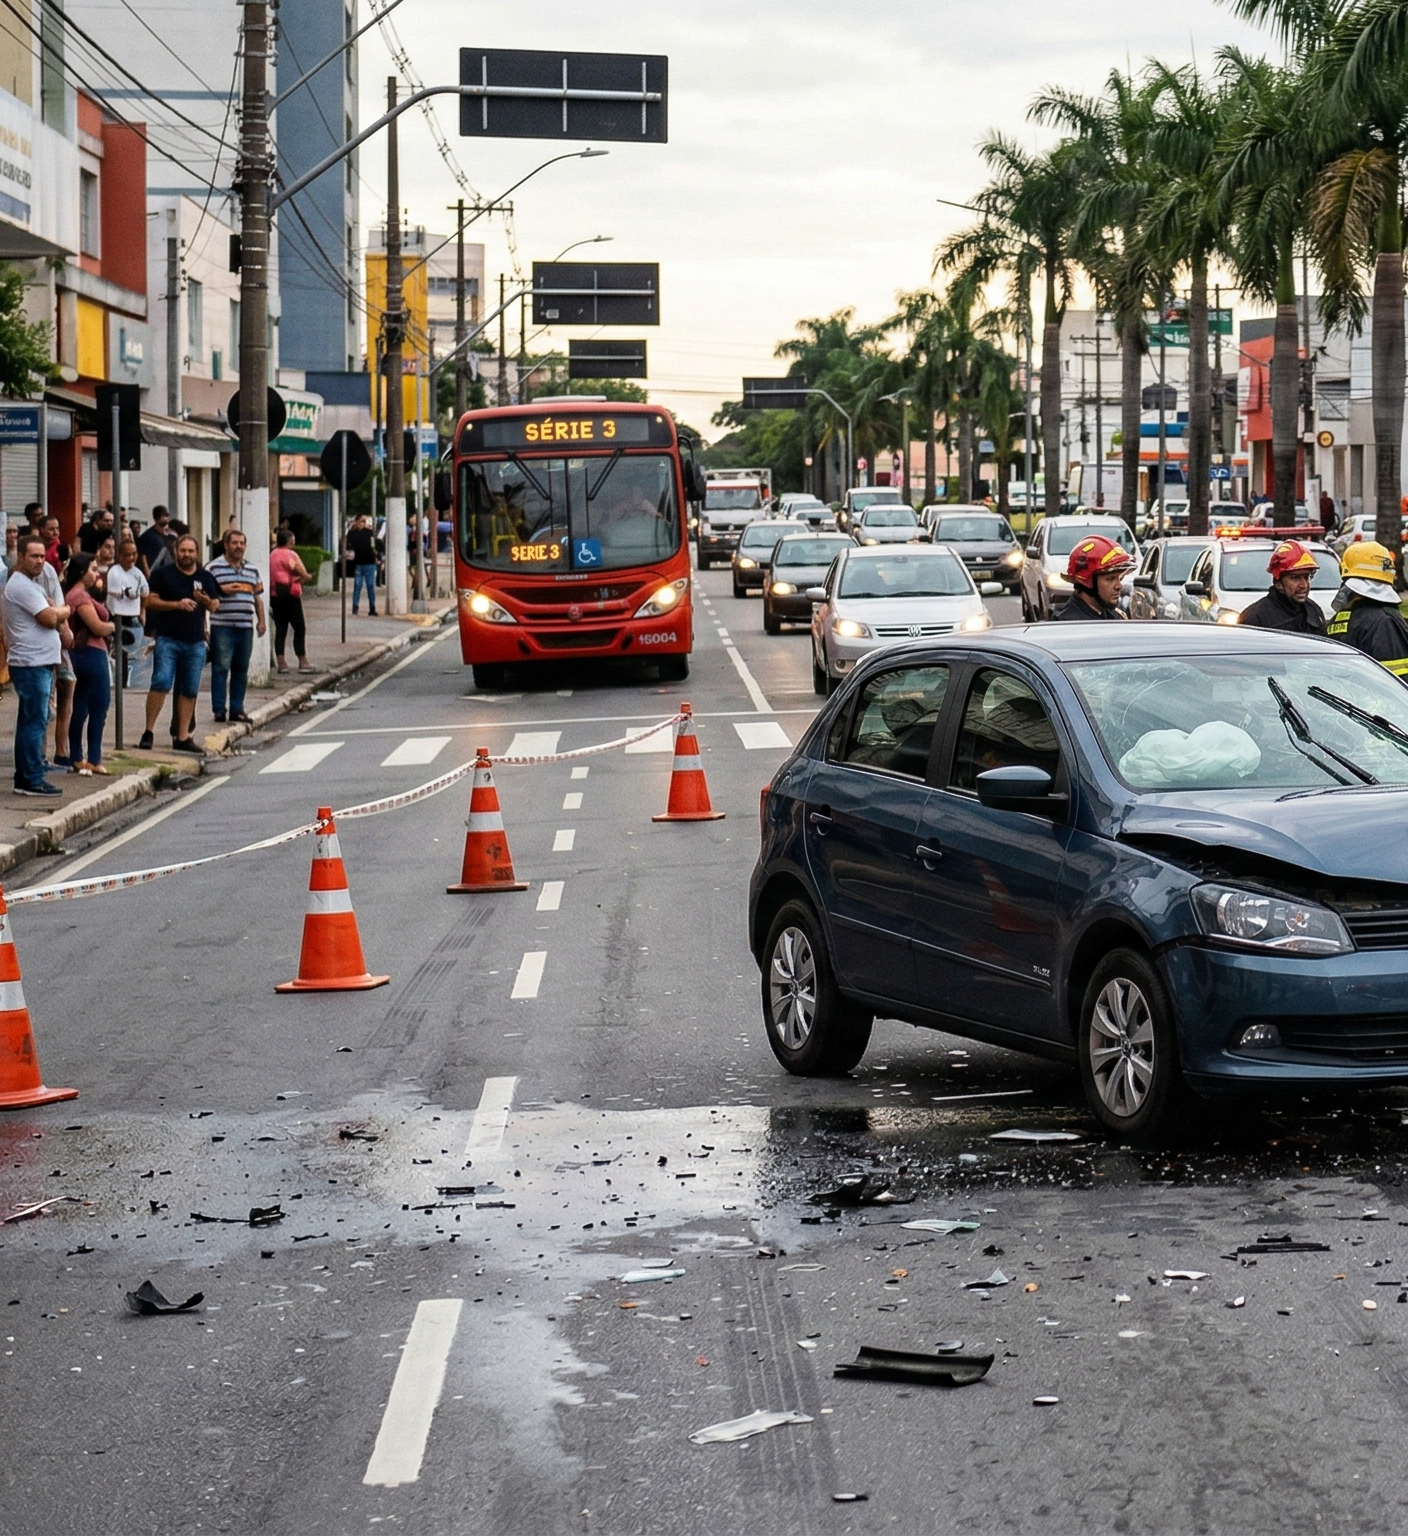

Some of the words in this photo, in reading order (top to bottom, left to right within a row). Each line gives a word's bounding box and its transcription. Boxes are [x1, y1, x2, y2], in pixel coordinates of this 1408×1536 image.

[525, 418, 594, 442] SÉRIE
[603, 420, 617, 438] 3
[550, 544, 560, 559] 3
